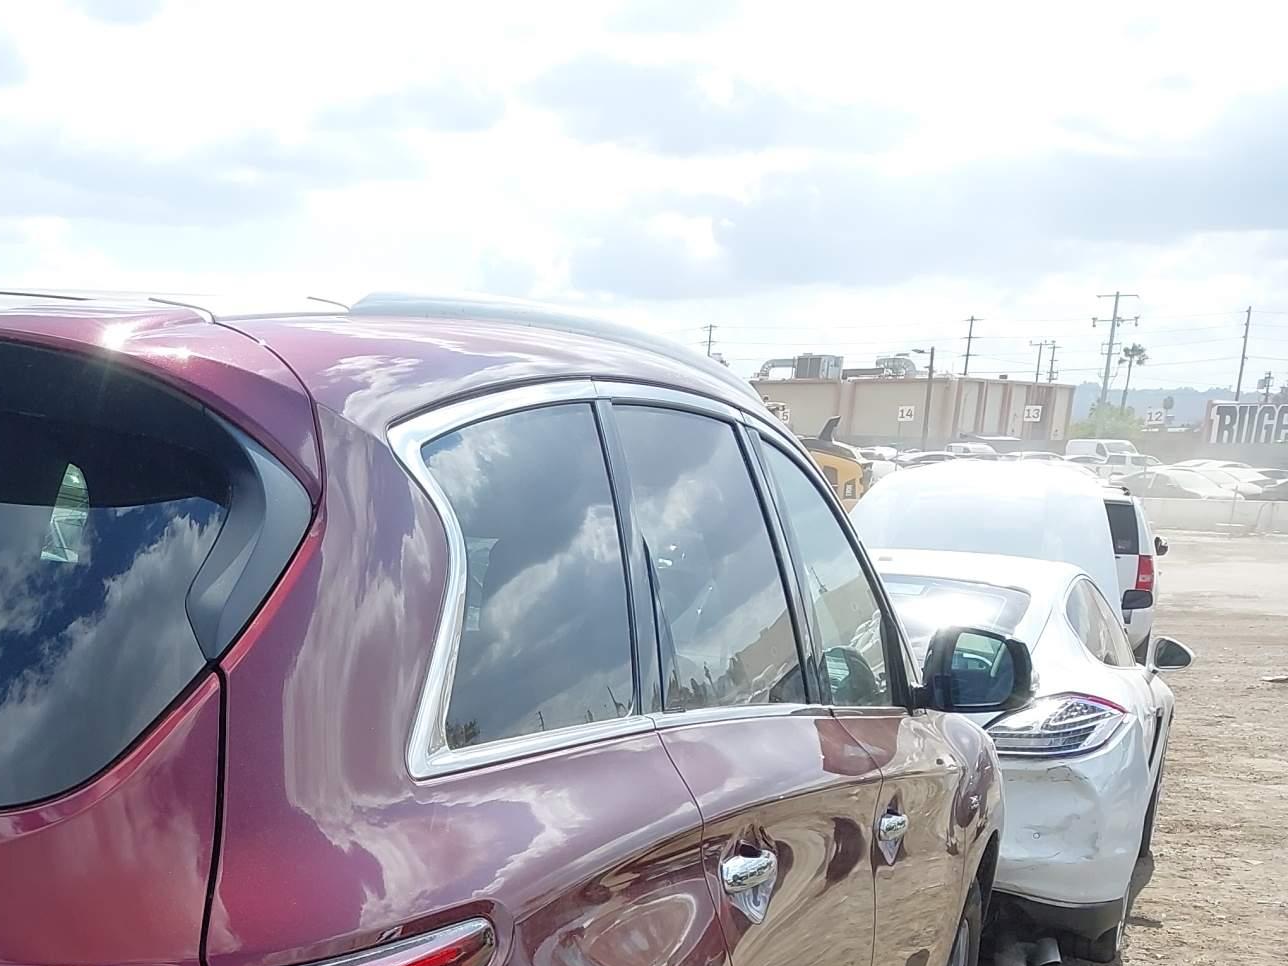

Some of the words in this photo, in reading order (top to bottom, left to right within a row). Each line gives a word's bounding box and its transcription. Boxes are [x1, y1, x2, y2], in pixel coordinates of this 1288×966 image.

[899, 408, 913, 419] 14
[1024, 408, 1040, 420] 13
[1147, 411, 1163, 422] 12
